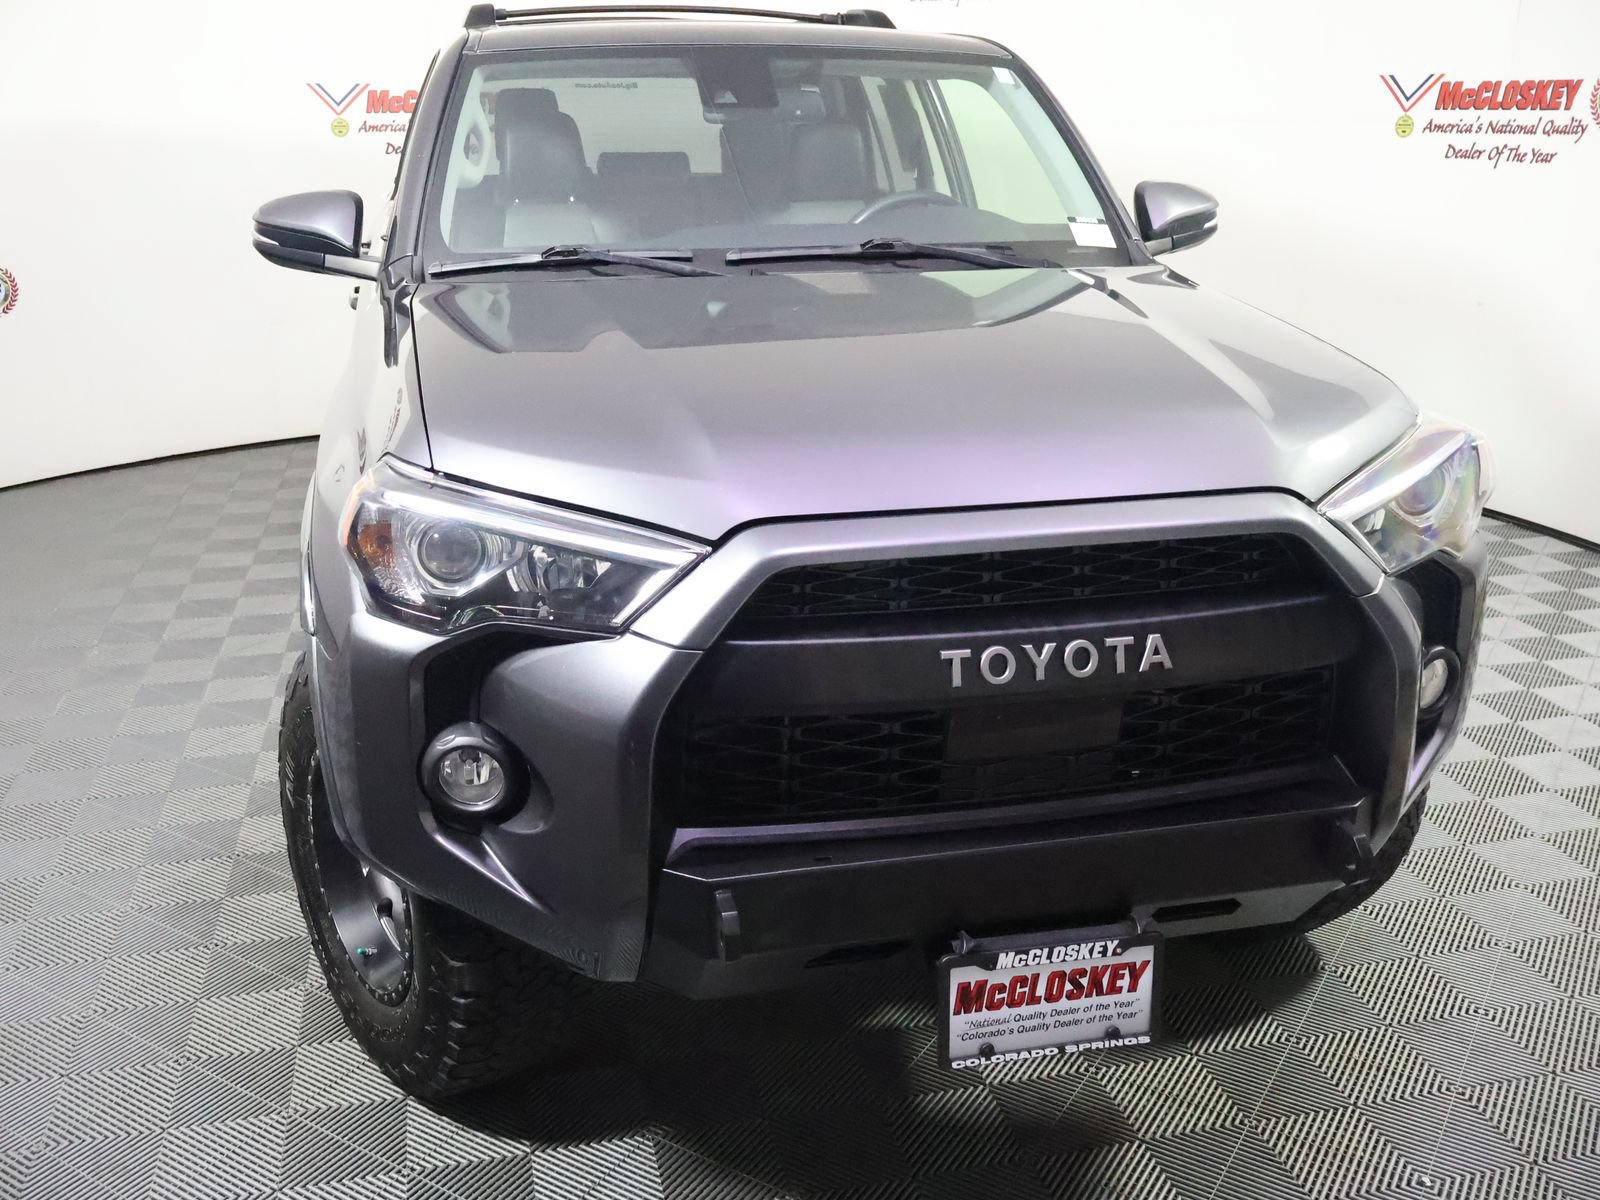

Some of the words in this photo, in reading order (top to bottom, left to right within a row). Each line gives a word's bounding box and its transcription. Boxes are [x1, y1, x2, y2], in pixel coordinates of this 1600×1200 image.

[1435, 79, 1584, 111] McCLOSKEY
[358, 120, 406, 133] America
[1422, 116, 1483, 134] America's
[1485, 117, 1542, 135] National
[1542, 116, 1589, 144] Quality
[1444, 142, 1486, 160] Dealer
[1487, 143, 1509, 169] Of
[1506, 145, 1528, 163] The
[1529, 147, 1558, 164] Year
[940, 633, 1173, 688] TOYOTA
[996, 939, 1119, 970] McCLOSKEY
[953, 960, 1151, 1015] McCLOSKEY
[1013, 1010, 1048, 1023] Quality
[1050, 1007, 1081, 1018] Dealer
[1083, 1004, 1094, 1013] of
[1095, 1002, 1110, 1011] the
[1017, 1021, 1051, 1034] Quality
[1053, 1018, 1084, 1029] Dealer
[1086, 1015, 1097, 1024] of
[1098, 1013, 1114, 1022] the
[951, 1047, 1059, 1069] COLORADO
[1065, 1036, 1151, 1053] SPRINGS
